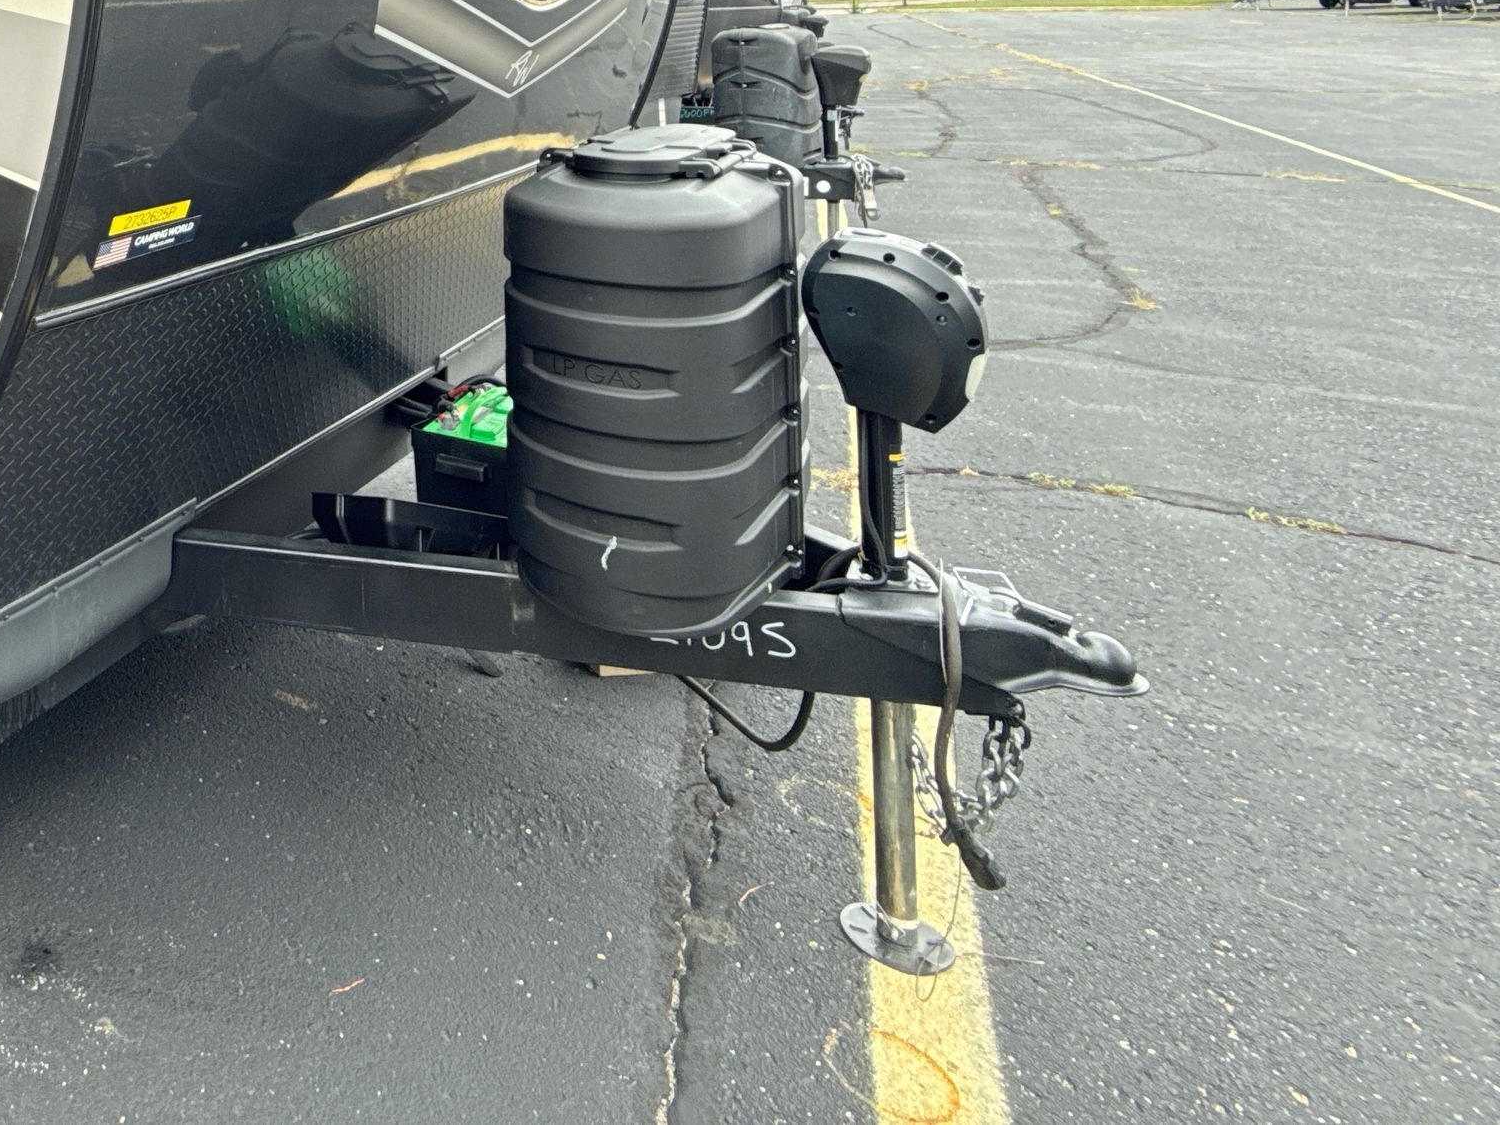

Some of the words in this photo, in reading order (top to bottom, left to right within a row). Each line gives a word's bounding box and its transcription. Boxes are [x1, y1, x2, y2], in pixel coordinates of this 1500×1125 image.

[123, 206, 177, 230] 2732625P
[134, 228, 169, 246] CAMPING
[168, 221, 195, 236] WORLD
[553, 355, 576, 376] LP
[584, 363, 642, 390] GAS
